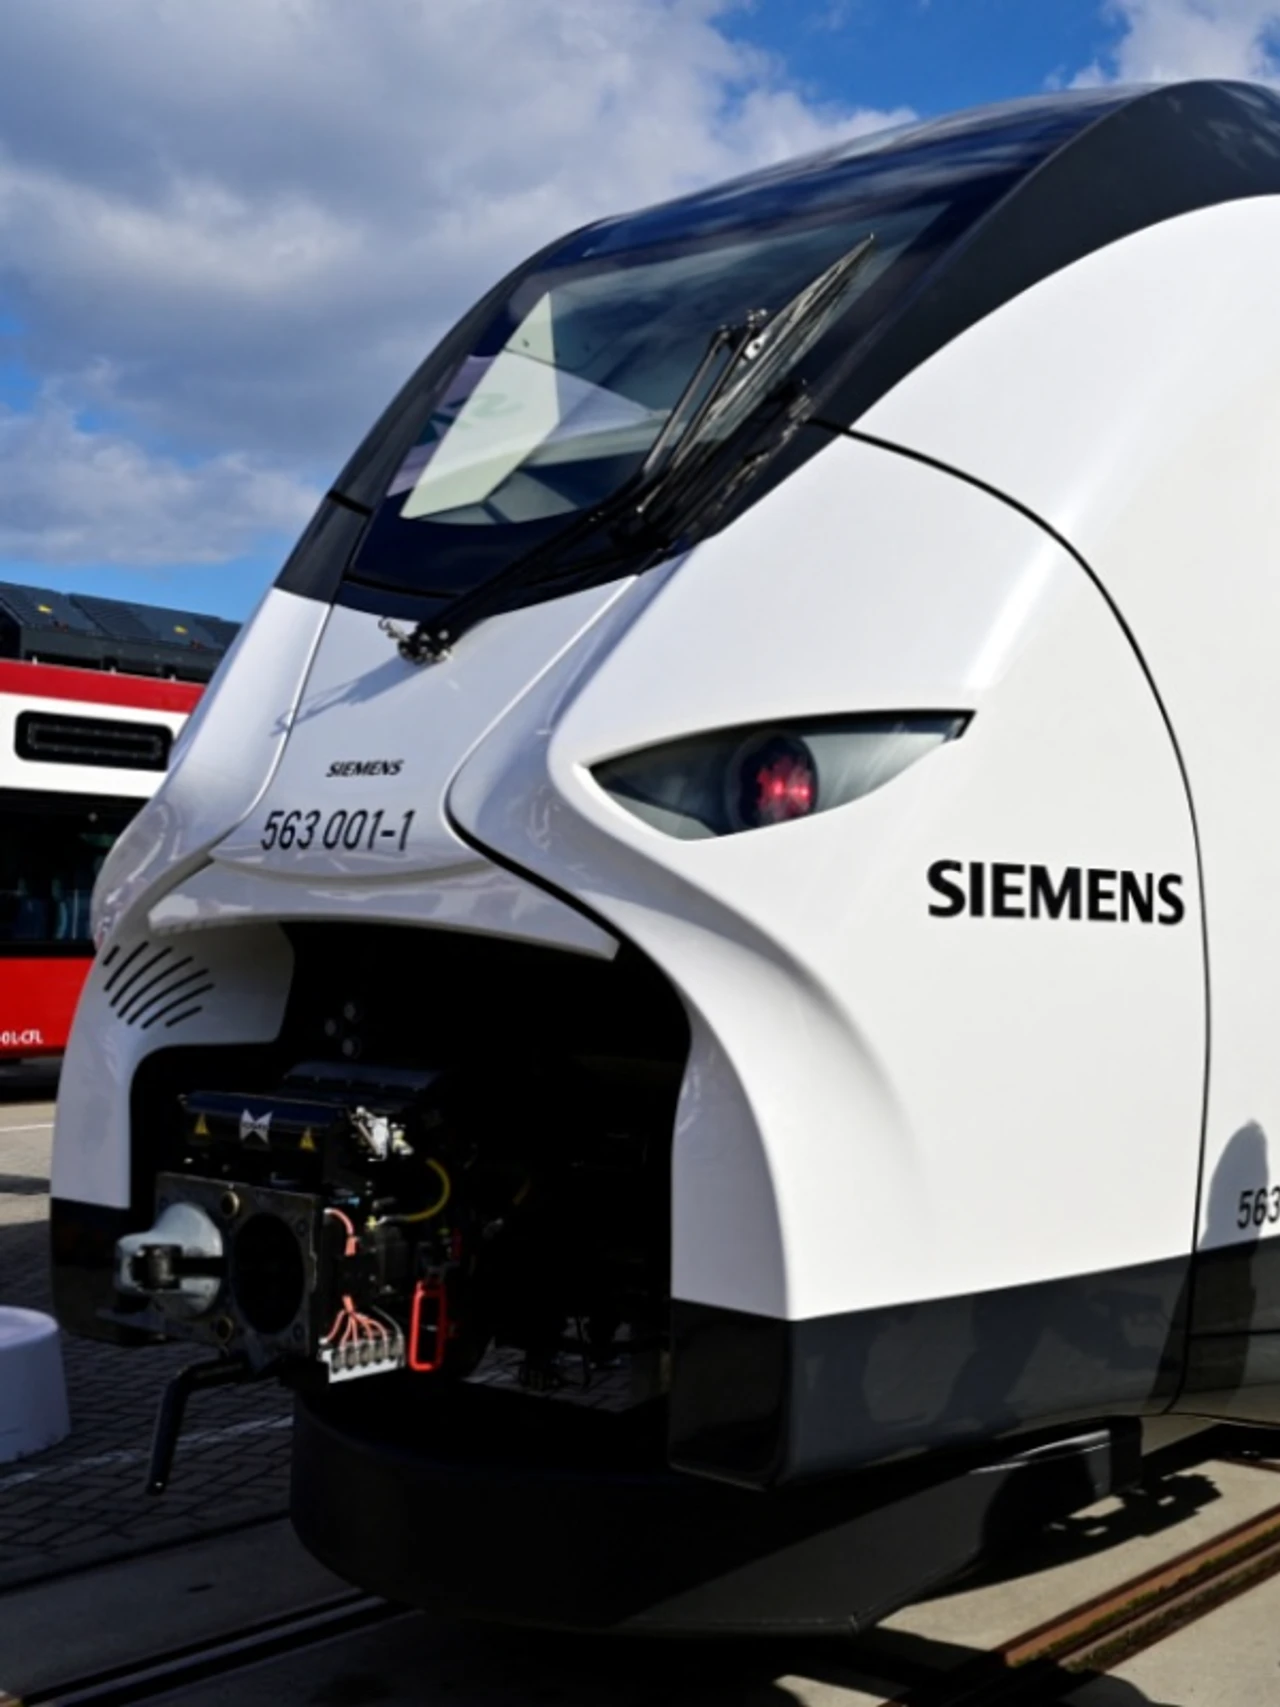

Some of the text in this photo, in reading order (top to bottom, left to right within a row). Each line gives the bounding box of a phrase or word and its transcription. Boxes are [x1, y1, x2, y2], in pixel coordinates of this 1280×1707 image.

[325, 759, 405, 778] SIEMENS
[260, 808, 416, 852] 563 001-1
[926, 858, 1186, 926] SIEMENS
